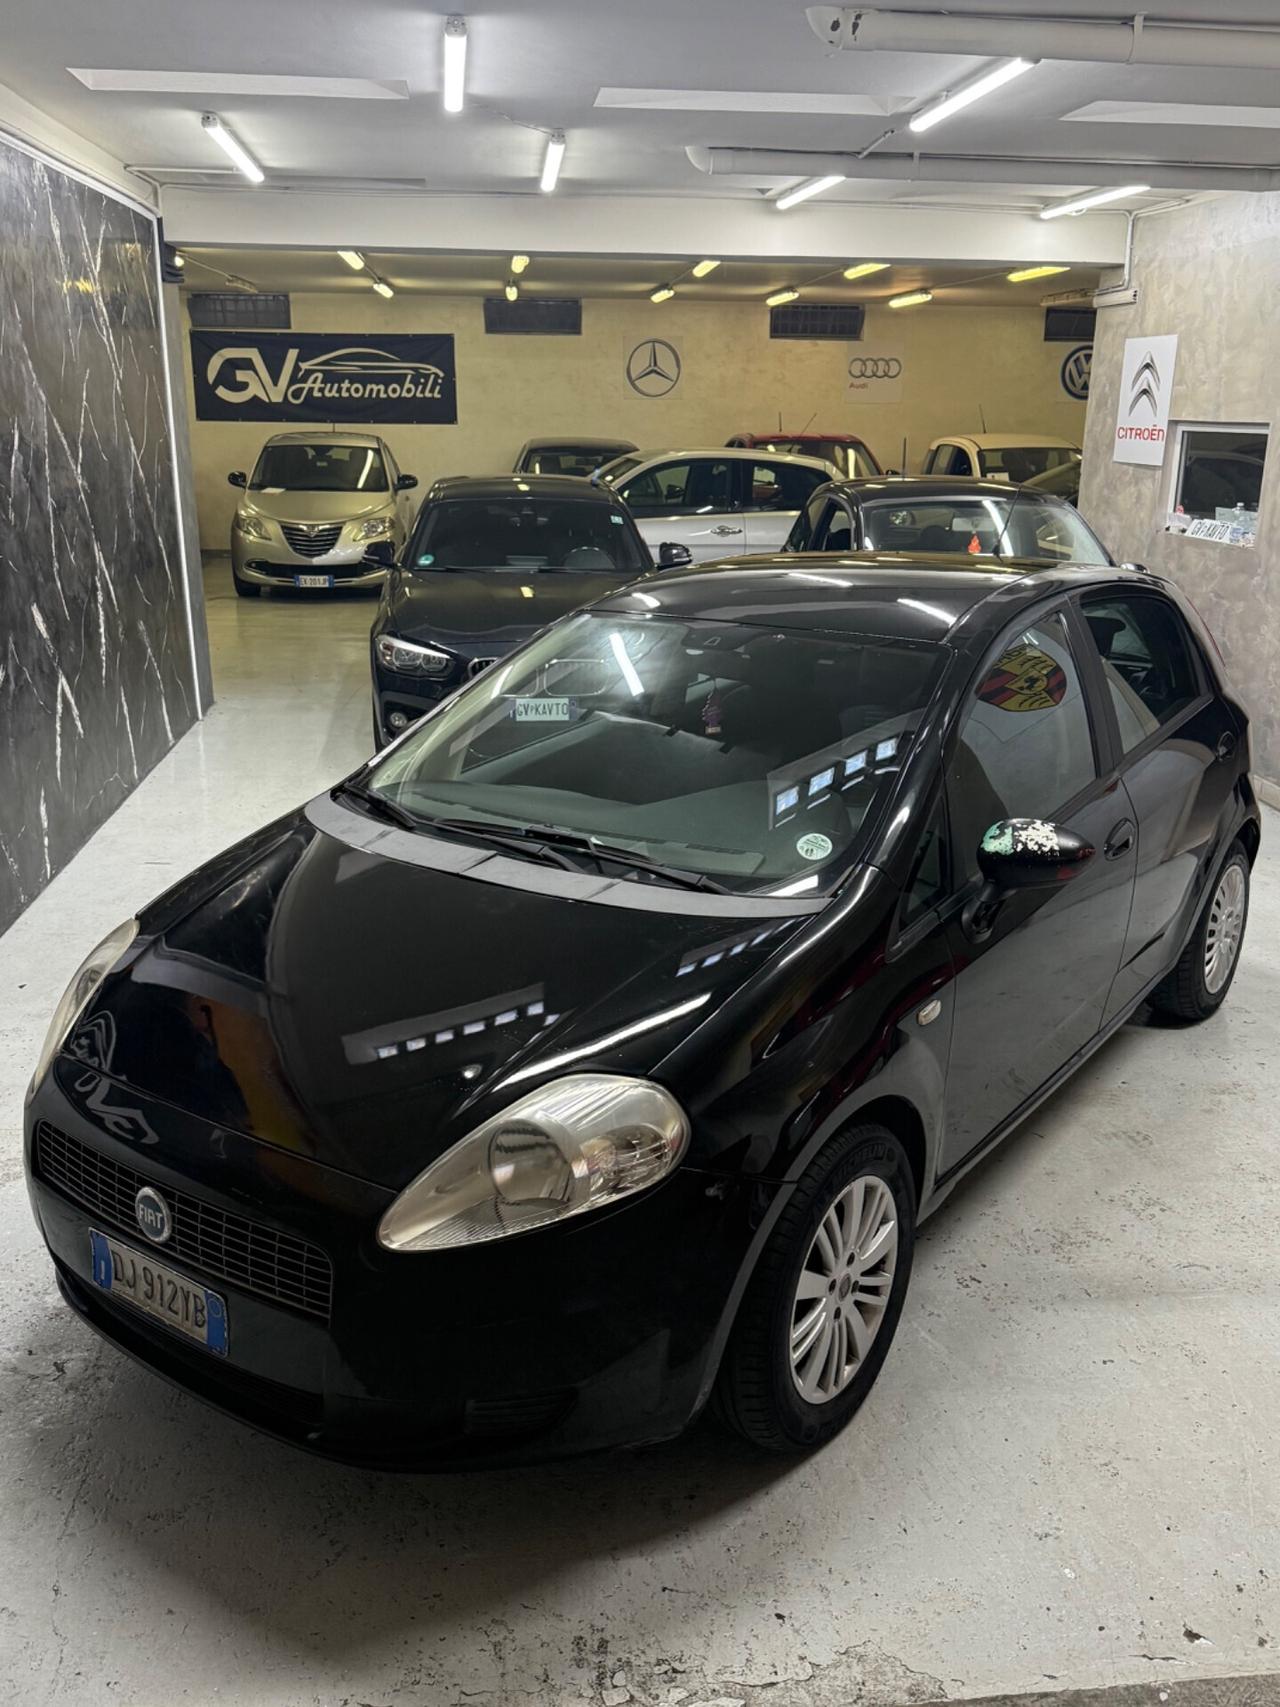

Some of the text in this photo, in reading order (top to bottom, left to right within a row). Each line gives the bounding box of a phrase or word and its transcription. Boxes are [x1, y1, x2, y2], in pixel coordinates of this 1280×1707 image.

[207, 347, 442, 404] GV Automobili
[1117, 424, 1165, 441] CITROËN
[138, 1204, 163, 1229] FIAT
